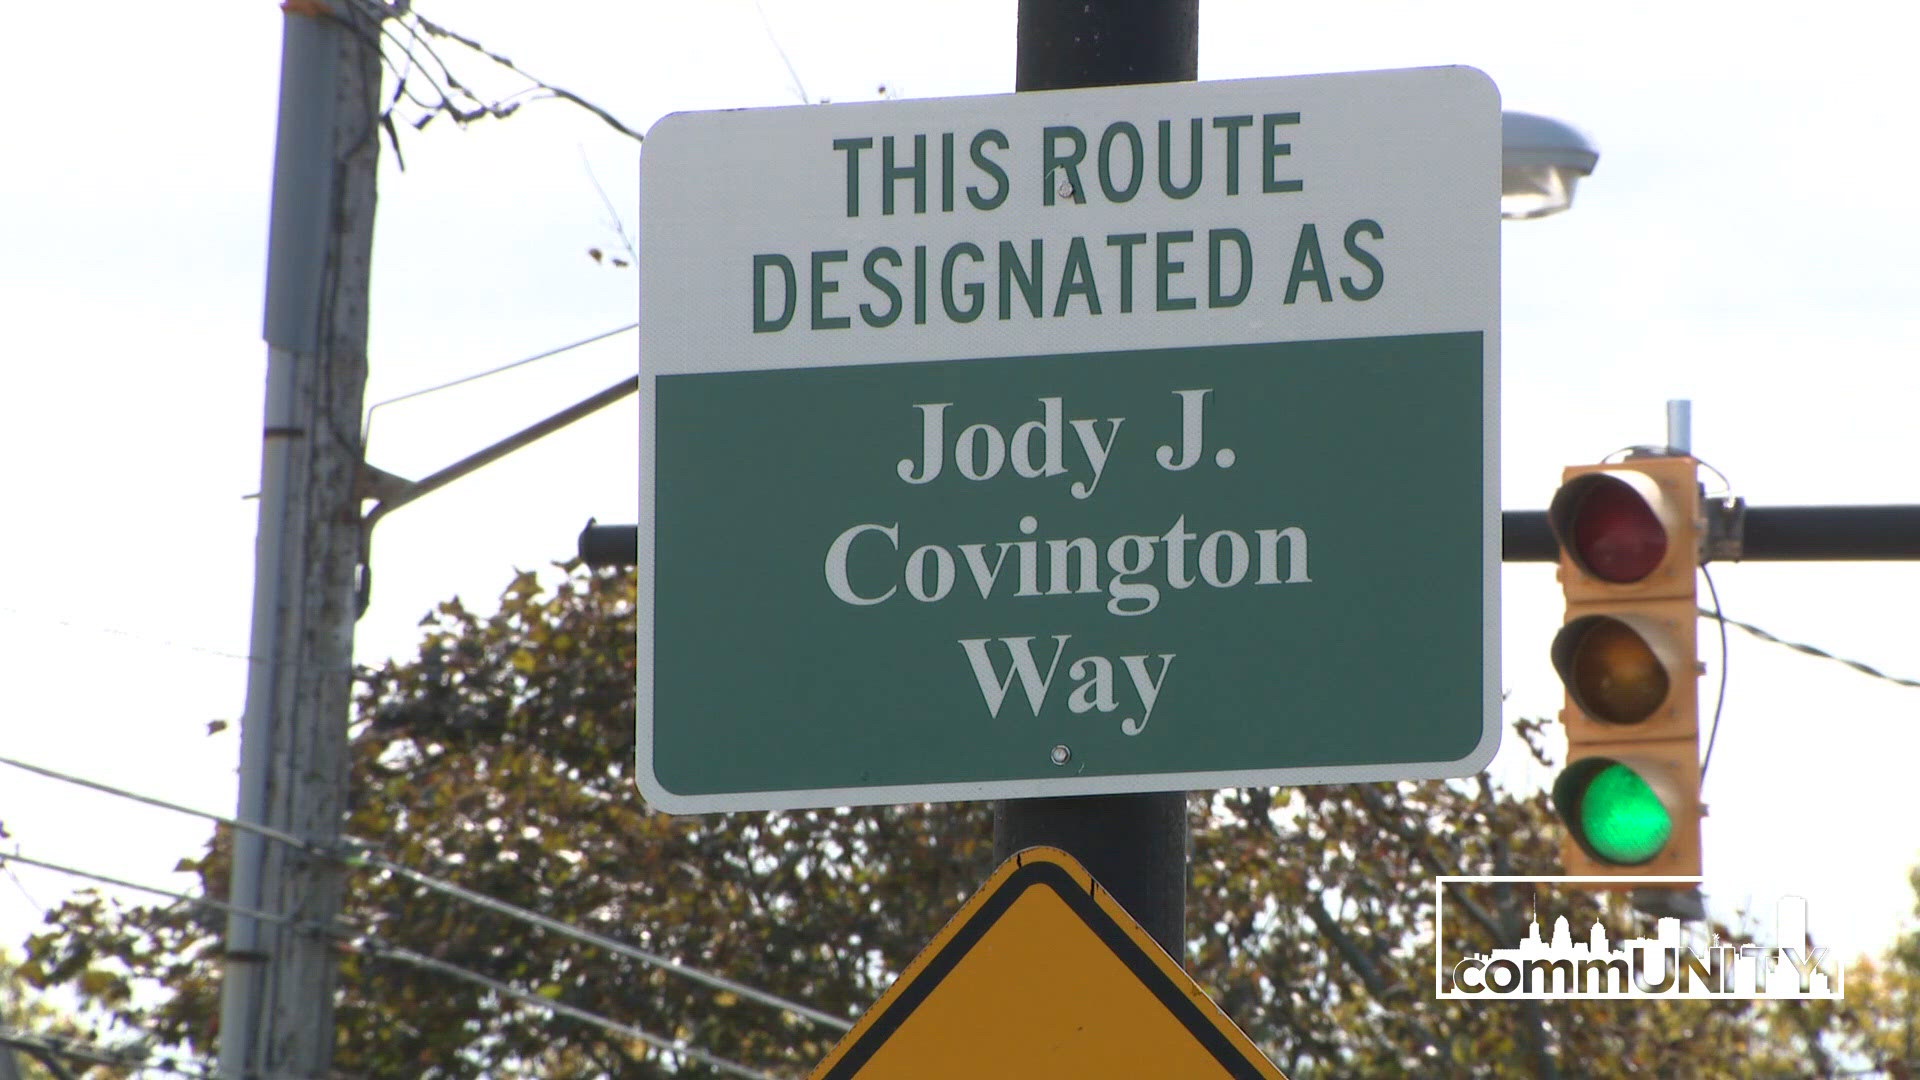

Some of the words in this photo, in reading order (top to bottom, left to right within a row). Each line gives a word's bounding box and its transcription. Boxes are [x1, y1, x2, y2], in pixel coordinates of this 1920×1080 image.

[833, 129, 1009, 217] THIS
[1043, 112, 1303, 206] ROUTE
[753, 228, 1253, 333] DESIGNATED
[1283, 219, 1384, 304] AS
[898, 397, 1124, 499] Jody
[1157, 390, 1235, 470] J.
[825, 515, 1312, 615] Covington
[958, 635, 1175, 735] Way
